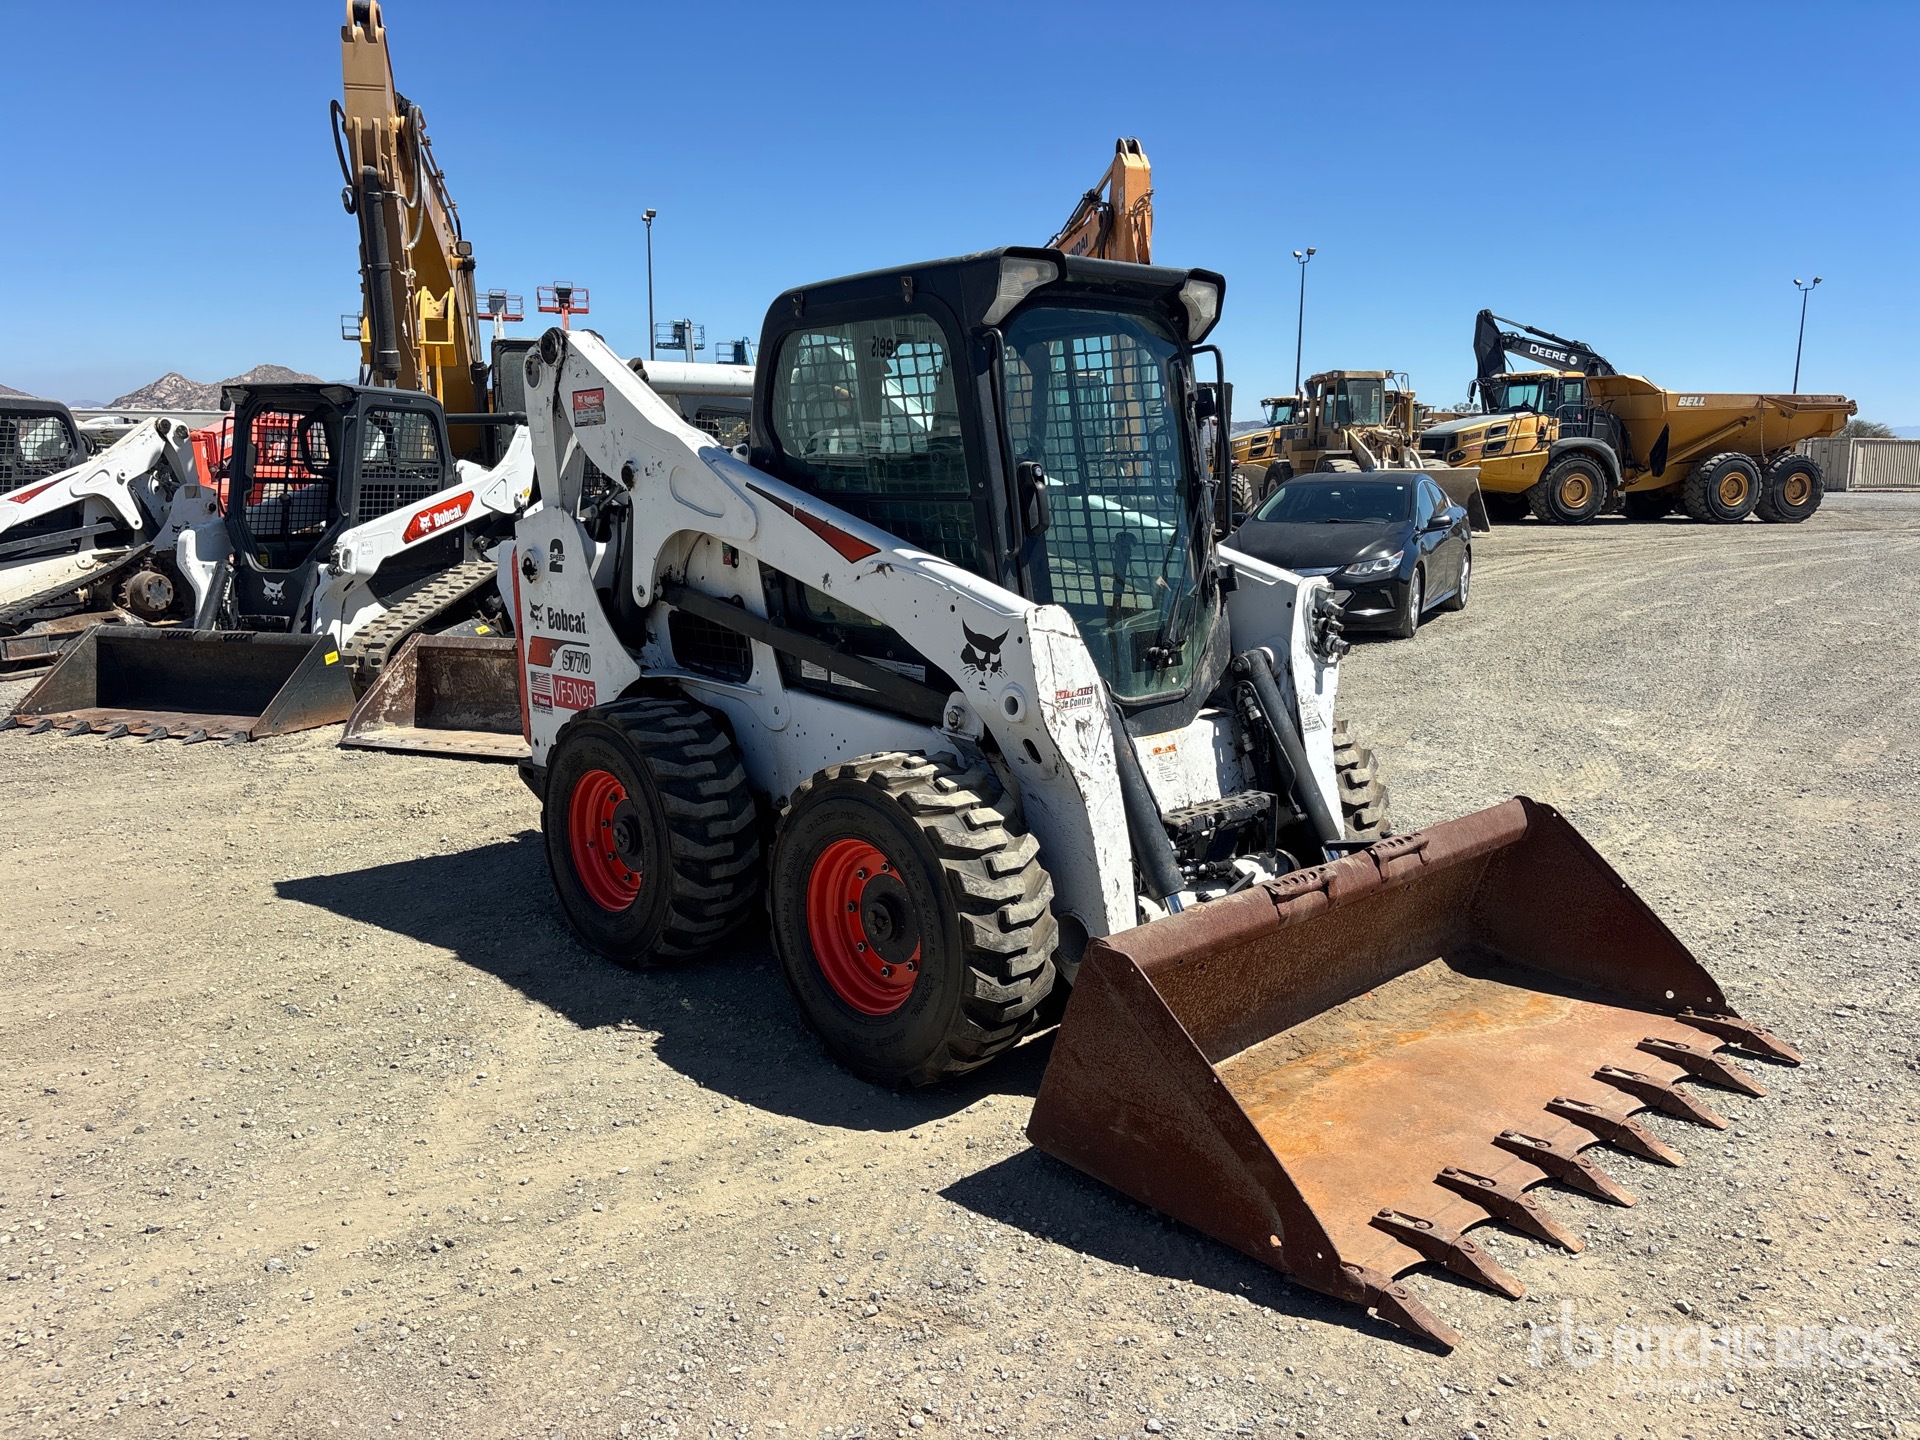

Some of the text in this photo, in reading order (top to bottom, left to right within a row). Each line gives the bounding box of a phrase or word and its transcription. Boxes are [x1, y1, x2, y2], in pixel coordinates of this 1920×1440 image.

[1529, 343, 1568, 362] DEERE
[1677, 396, 1706, 407] BELL
[433, 504, 463, 527] Bobcat
[547, 606, 586, 635] Bobcat
[562, 649, 591, 674] S770
[552, 679, 596, 708] VF5N95
[1070, 695, 1093, 707] Control
